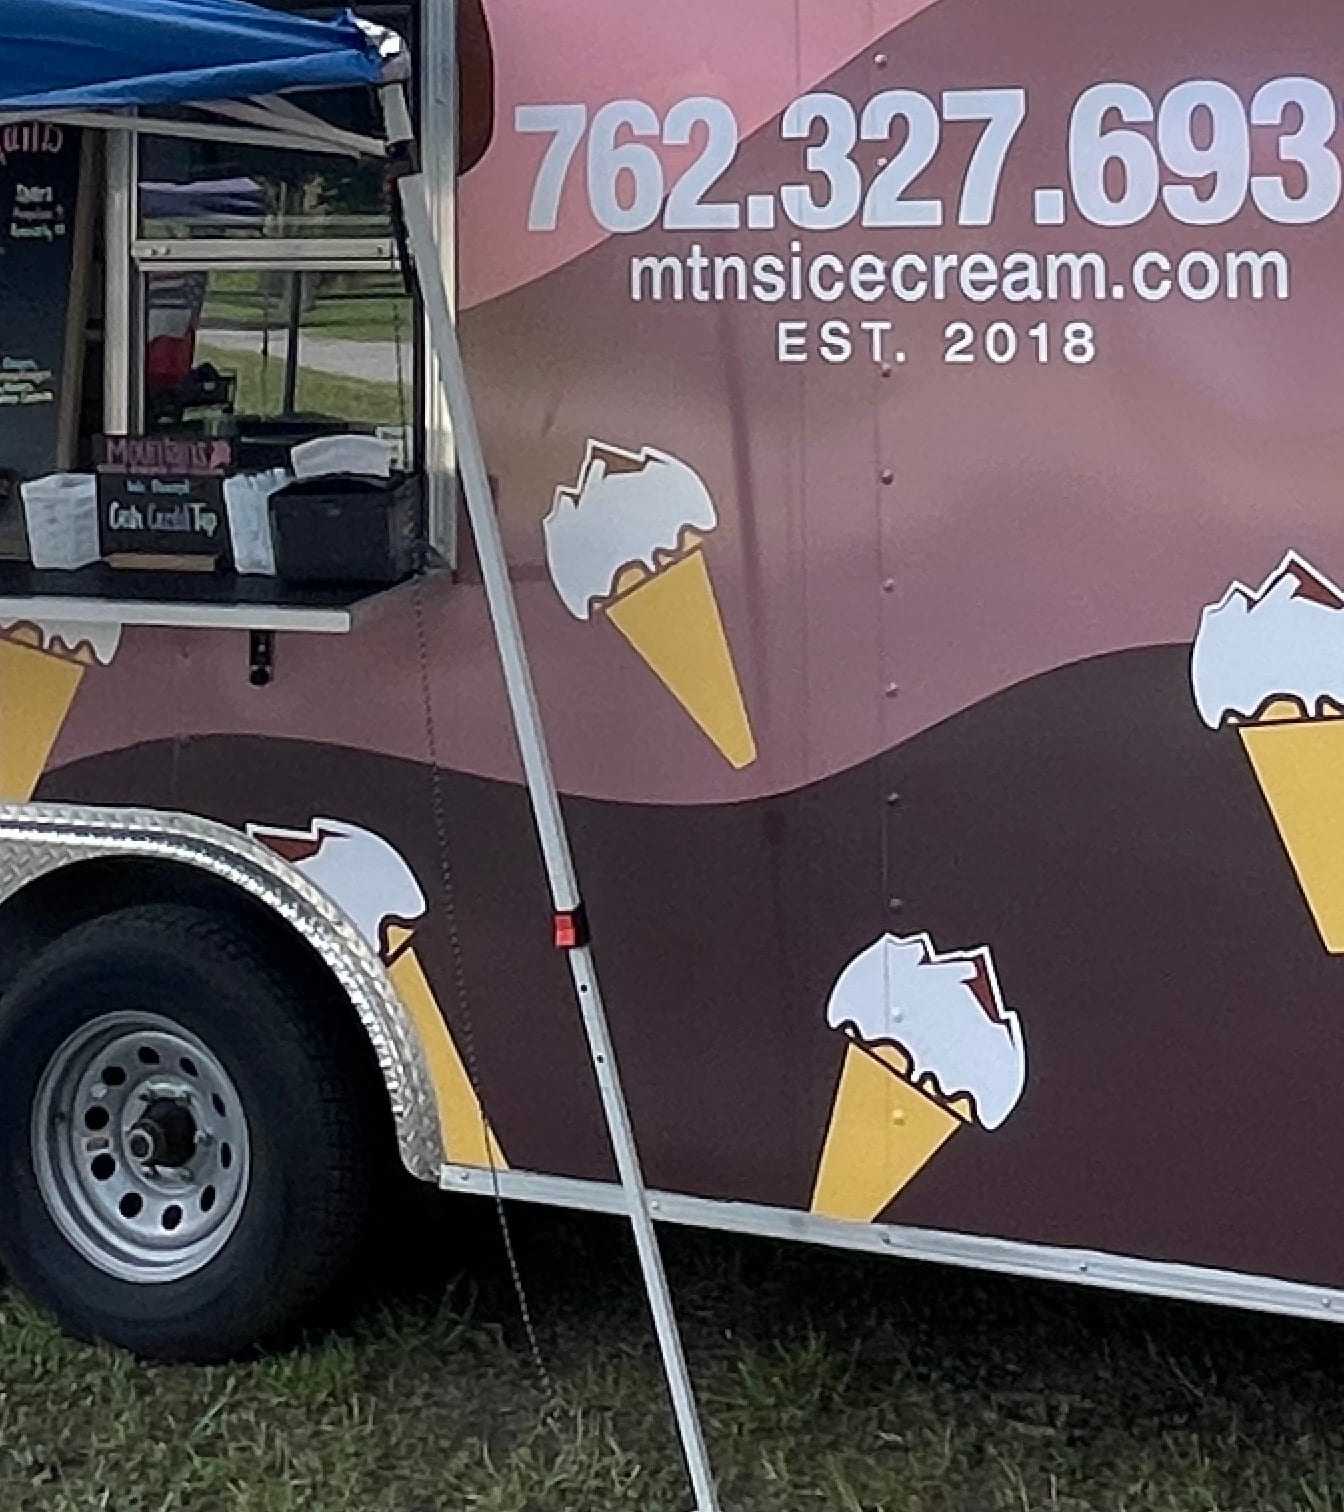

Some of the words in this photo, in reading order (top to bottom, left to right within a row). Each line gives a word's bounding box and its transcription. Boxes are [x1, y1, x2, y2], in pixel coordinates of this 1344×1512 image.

[631, 241, 1289, 303] mtnsicecream.com
[778, 321, 905, 364] EST.
[944, 321, 1096, 365] 2018
